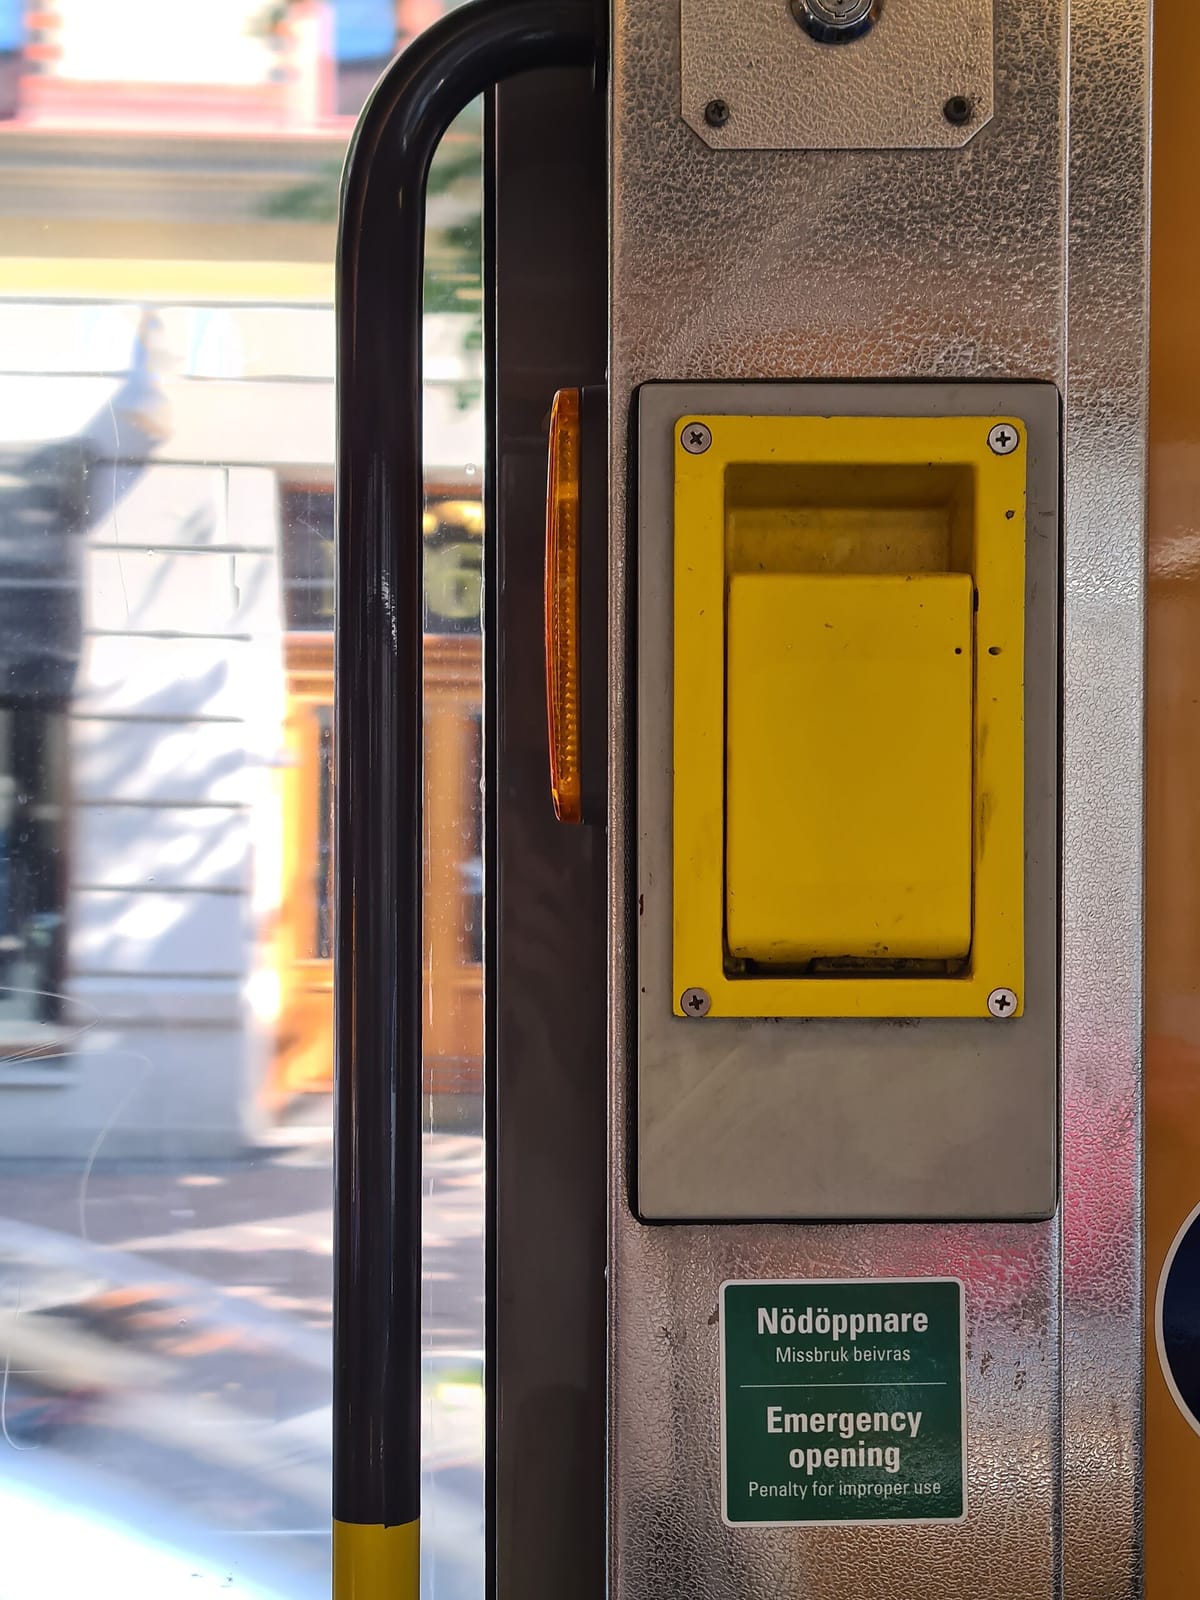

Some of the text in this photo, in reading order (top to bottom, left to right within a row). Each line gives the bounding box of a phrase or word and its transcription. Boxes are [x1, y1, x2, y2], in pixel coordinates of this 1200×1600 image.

[757, 1306, 929, 1341] Nödöppnare
[776, 1346, 911, 1363] Missbruk beivras
[767, 1406, 923, 1439] Emergency
[789, 1441, 901, 1475] opening
[749, 1480, 942, 1500] Penalty for improper use
